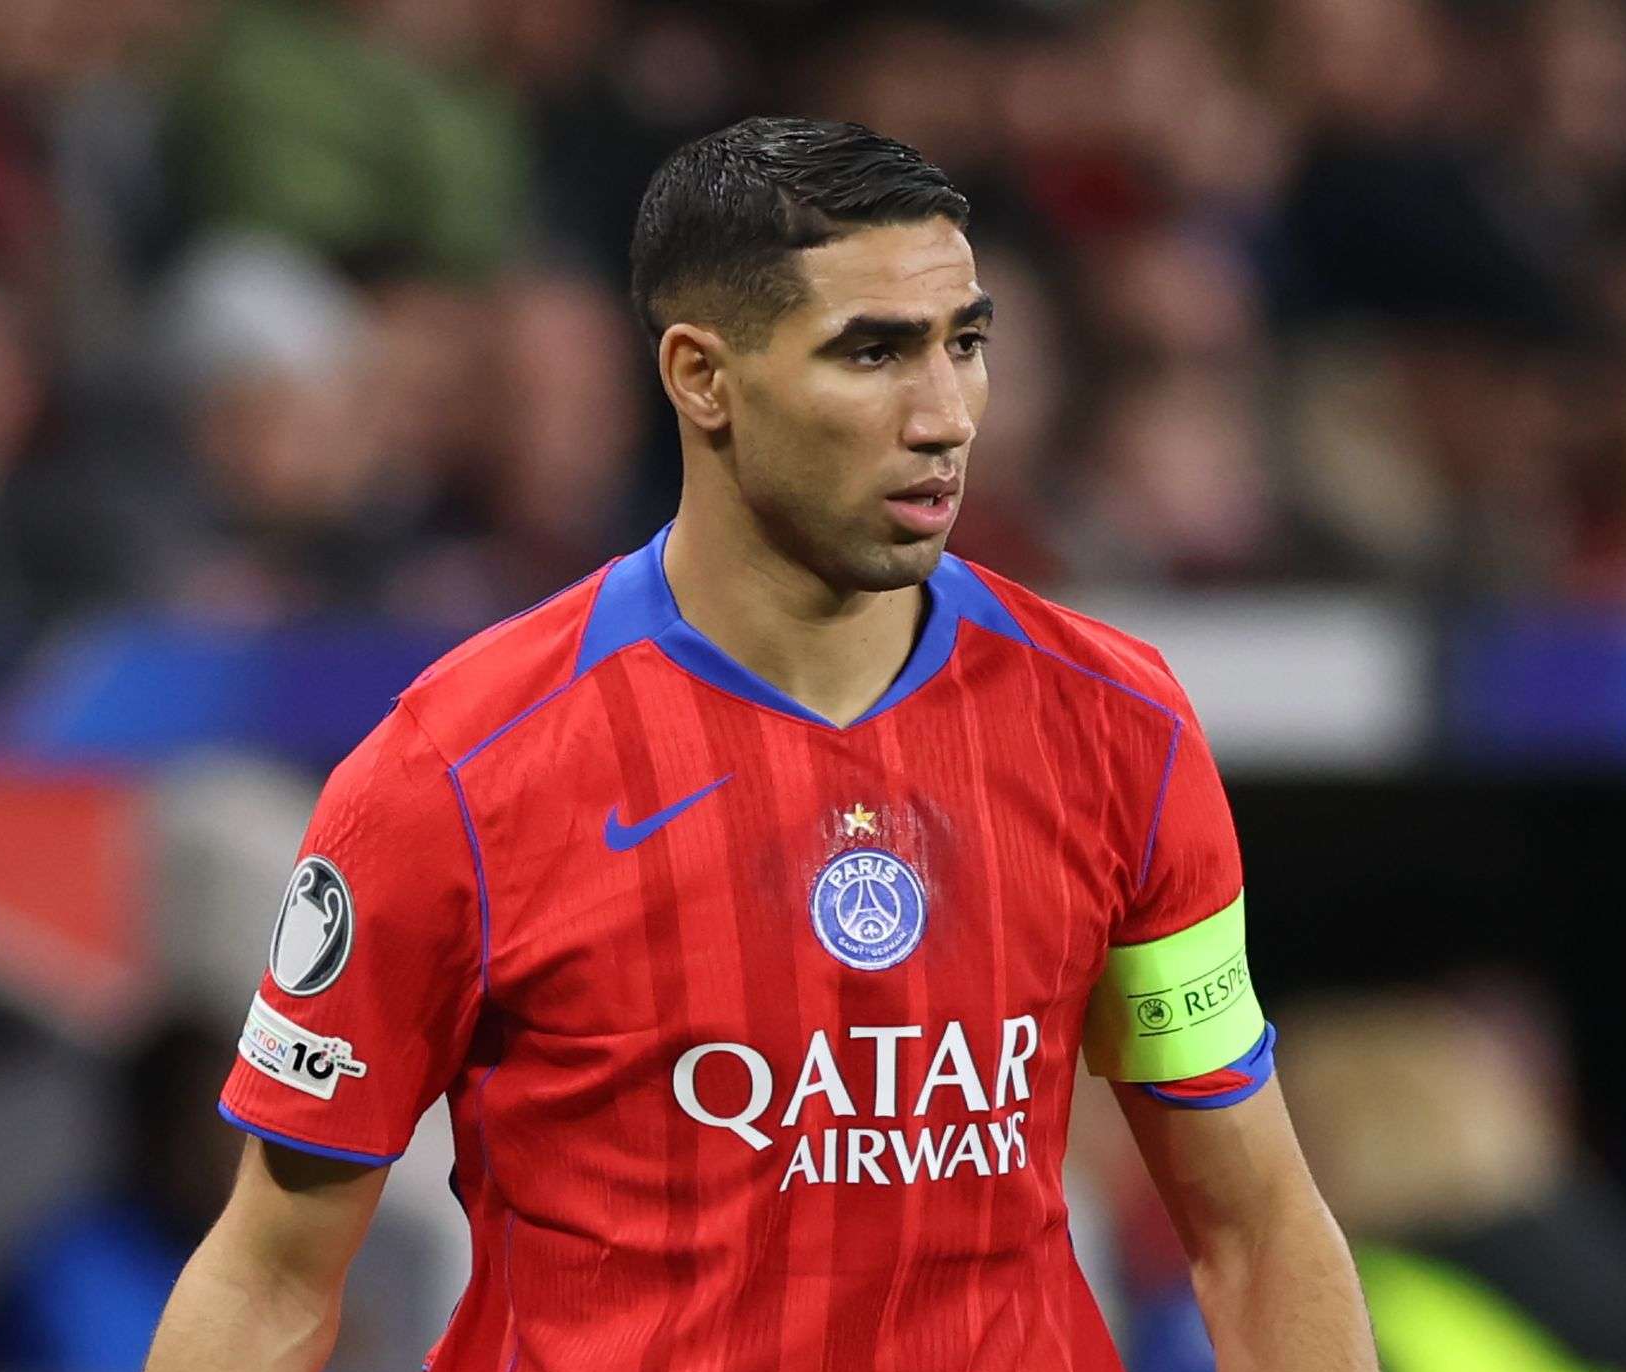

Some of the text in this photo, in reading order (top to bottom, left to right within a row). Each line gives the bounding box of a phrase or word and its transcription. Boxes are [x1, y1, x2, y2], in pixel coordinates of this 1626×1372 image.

[828, 858, 899, 890] PARIS
[672, 1014, 1037, 1151] QATAR
[779, 1111, 1025, 1193] AIRWAYS
